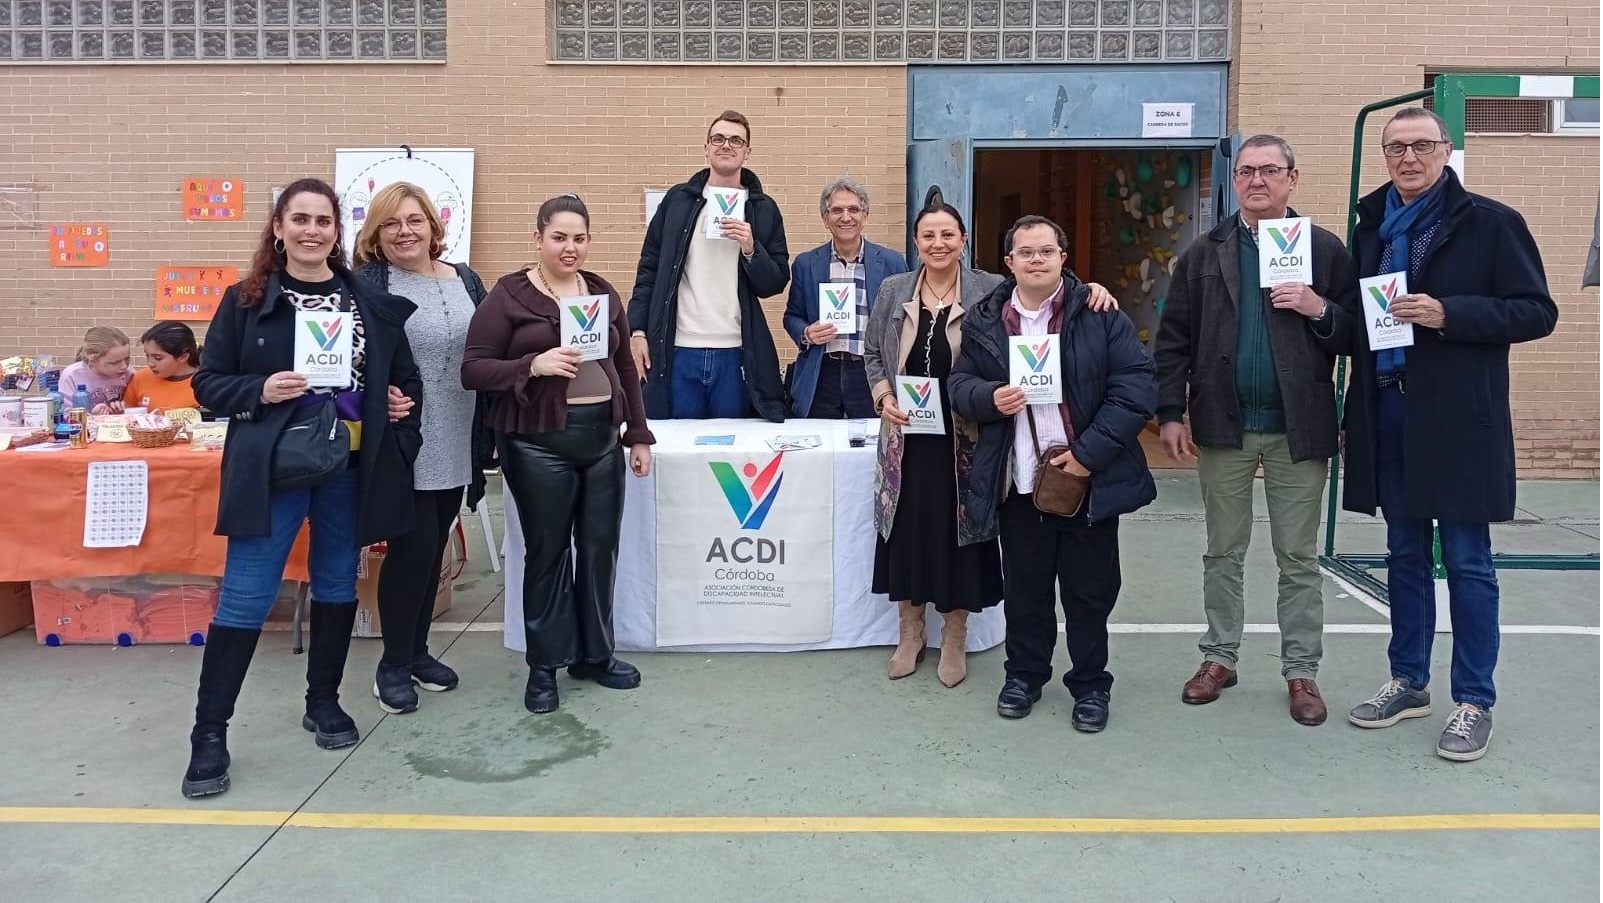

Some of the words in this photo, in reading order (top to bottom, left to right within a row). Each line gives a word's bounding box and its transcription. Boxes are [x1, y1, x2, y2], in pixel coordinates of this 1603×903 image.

[1269, 256, 1303, 268] ACDI
[826, 312, 850, 320] ACDI
[570, 333, 601, 345] ACDI
[305, 354, 343, 365] ACDI
[1020, 375, 1053, 386] ACDI
[908, 410, 936, 419] ACDI
[705, 536, 785, 565] ACDI
[714, 568, 775, 582] Córdoba
[749, 591, 785, 599] INTELECTUAL
